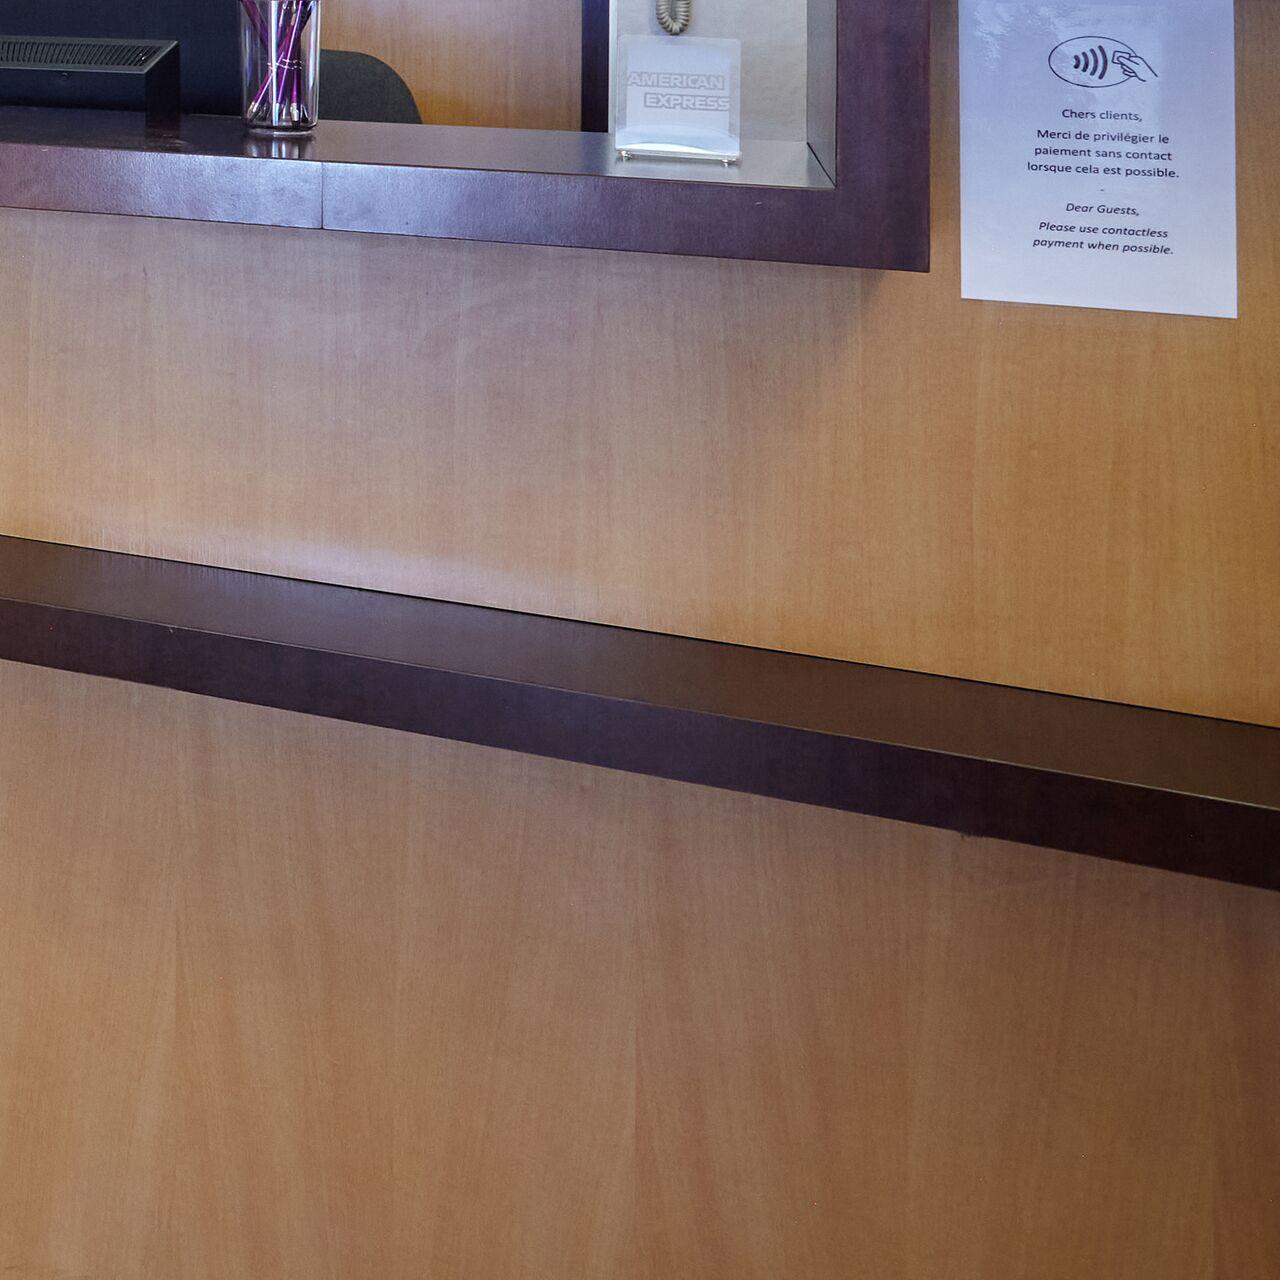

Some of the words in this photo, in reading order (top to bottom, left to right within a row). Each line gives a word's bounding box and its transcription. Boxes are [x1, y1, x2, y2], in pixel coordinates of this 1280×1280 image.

[627, 71, 725, 91] AMERICAN
[644, 92, 730, 112] EXPRESS
[1061, 108, 1096, 120] Chers
[1099, 110, 1143, 122] clients,
[1036, 129, 1071, 140] Merci
[1074, 130, 1091, 141] de
[1093, 131, 1155, 145] privilégier
[1158, 133, 1170, 144] le
[1034, 145, 1092, 158] paiement
[1095, 149, 1122, 159] sans
[1125, 150, 1173, 161] contact
[1027, 161, 1072, 175] lorsque
[1075, 164, 1100, 175] cela
[1103, 166, 1122, 175] est
[1124, 167, 1180, 179] possible.
[1065, 202, 1094, 213] Dear
[1097, 204, 1140, 217] Guests,
[1038, 221, 1076, 233] Please
[1079, 225, 1099, 234] use
[1101, 226, 1168, 239] contactless
[1032, 238, 1085, 250] payment
[1087, 241, 1119, 251] when
[1122, 243, 1174, 255] possible.
